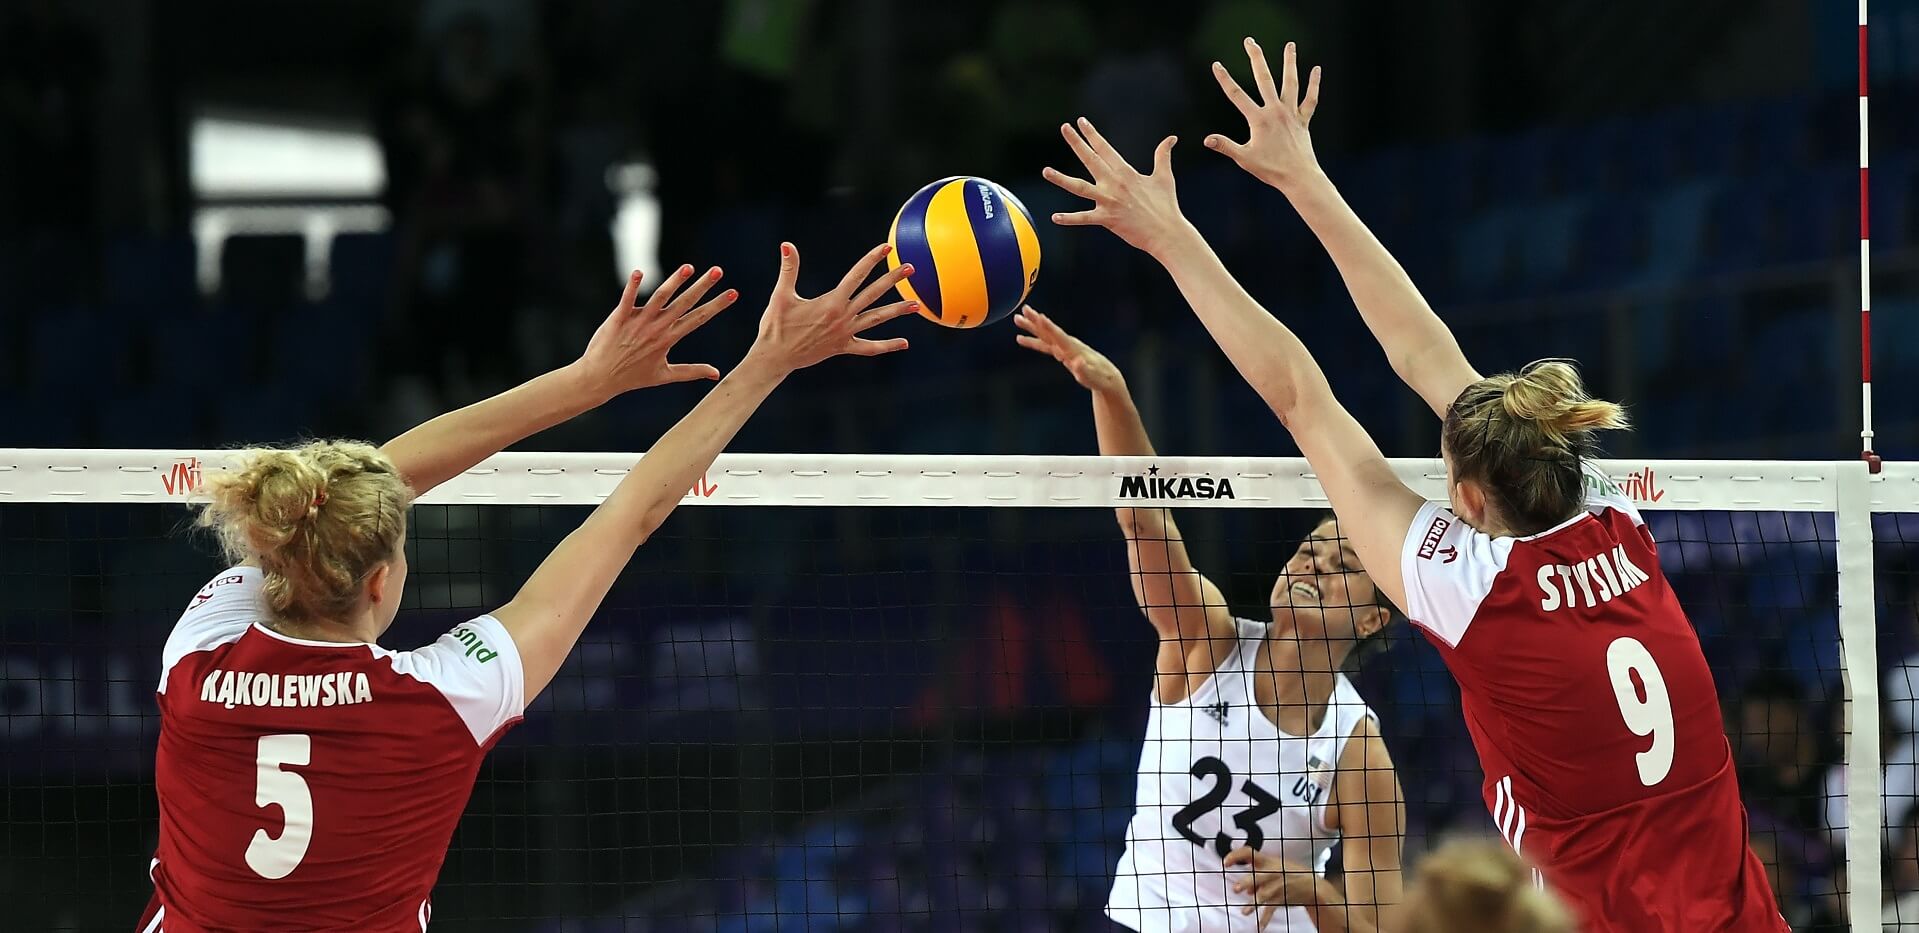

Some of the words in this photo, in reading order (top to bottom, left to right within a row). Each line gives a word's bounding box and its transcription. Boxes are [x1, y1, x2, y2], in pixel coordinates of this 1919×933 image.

[977, 184, 994, 220] MIKASA
[1118, 475, 1236, 500] MIKASA
[1419, 518, 1448, 558] ORLEN
[1537, 543, 1650, 612] STYSIAK
[453, 628, 498, 664] plus
[200, 669, 373, 709] KĄKOLEWSKA
[1606, 636, 1675, 787] 9
[244, 733, 314, 880] 5
[1172, 755, 1282, 862] 23
